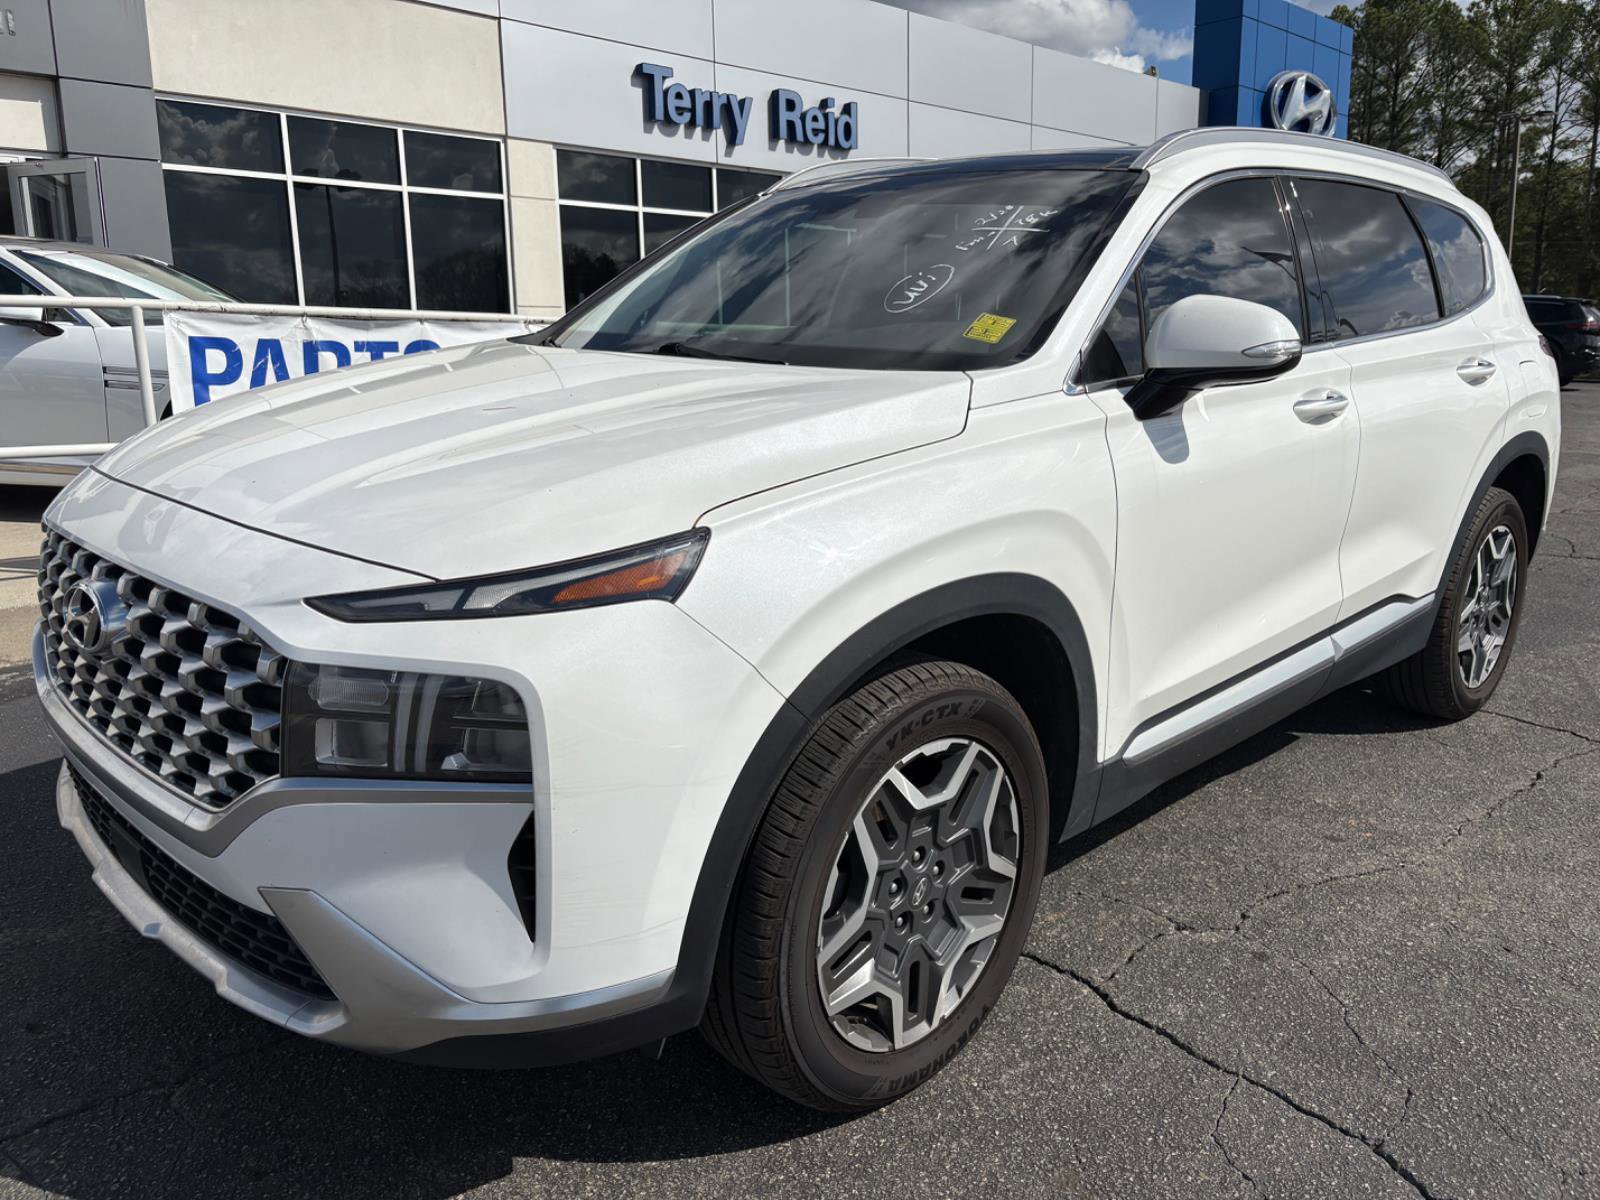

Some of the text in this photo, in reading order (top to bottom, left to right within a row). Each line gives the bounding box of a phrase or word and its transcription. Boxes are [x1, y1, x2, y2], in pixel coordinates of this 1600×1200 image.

[632, 63, 858, 150] Terry Reid
[886, 1004, 991, 1093] YOKOHAMA
